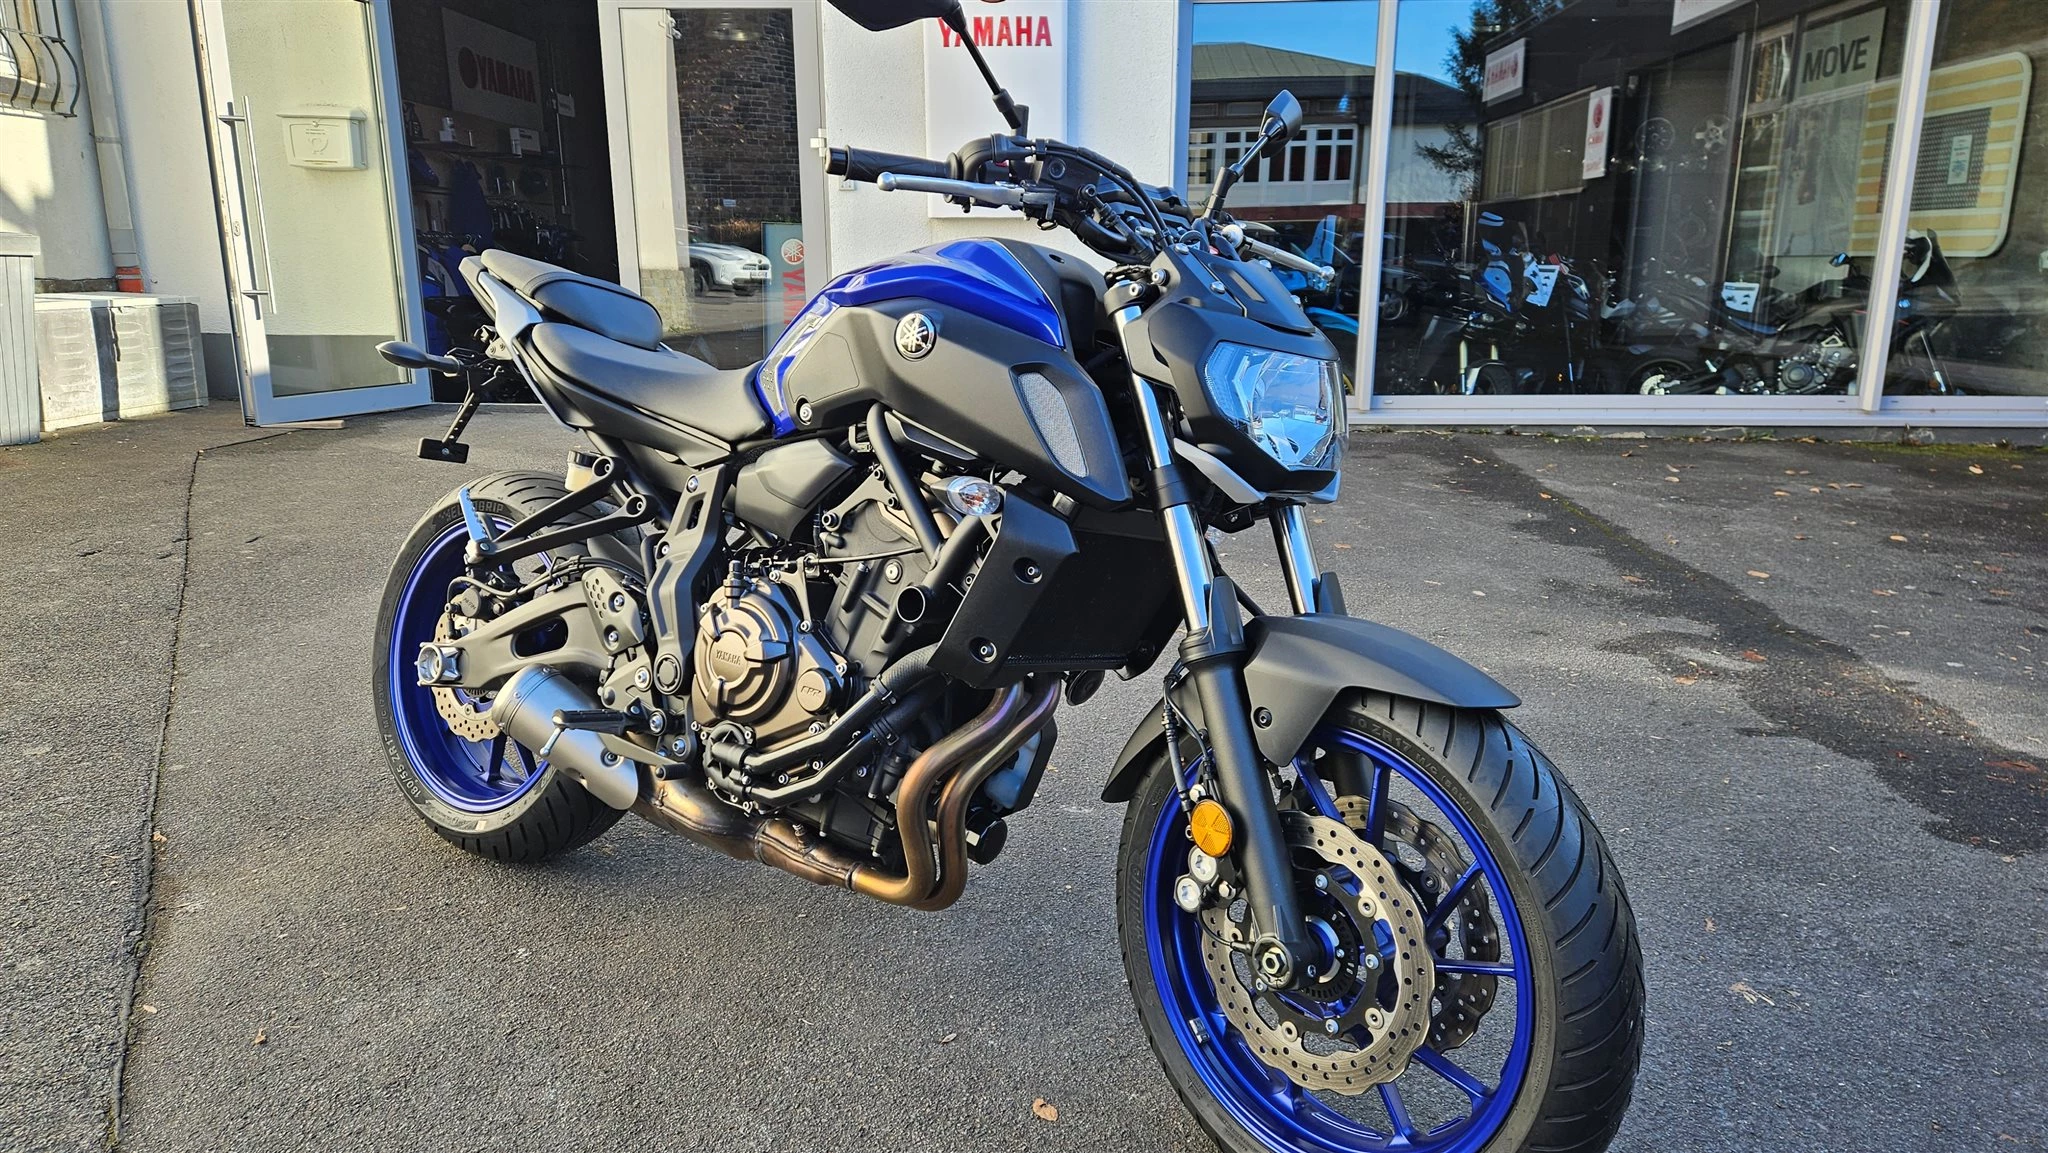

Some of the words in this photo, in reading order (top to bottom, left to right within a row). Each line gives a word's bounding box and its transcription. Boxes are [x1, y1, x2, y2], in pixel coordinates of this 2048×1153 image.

[937, 16, 1052, 47] YMAHA
[1802, 35, 1870, 83] MOVE
[475, 53, 537, 103] YAMAHA
[716, 649, 741, 666] YAMAHA
[396, 764, 422, 799] 180/55
